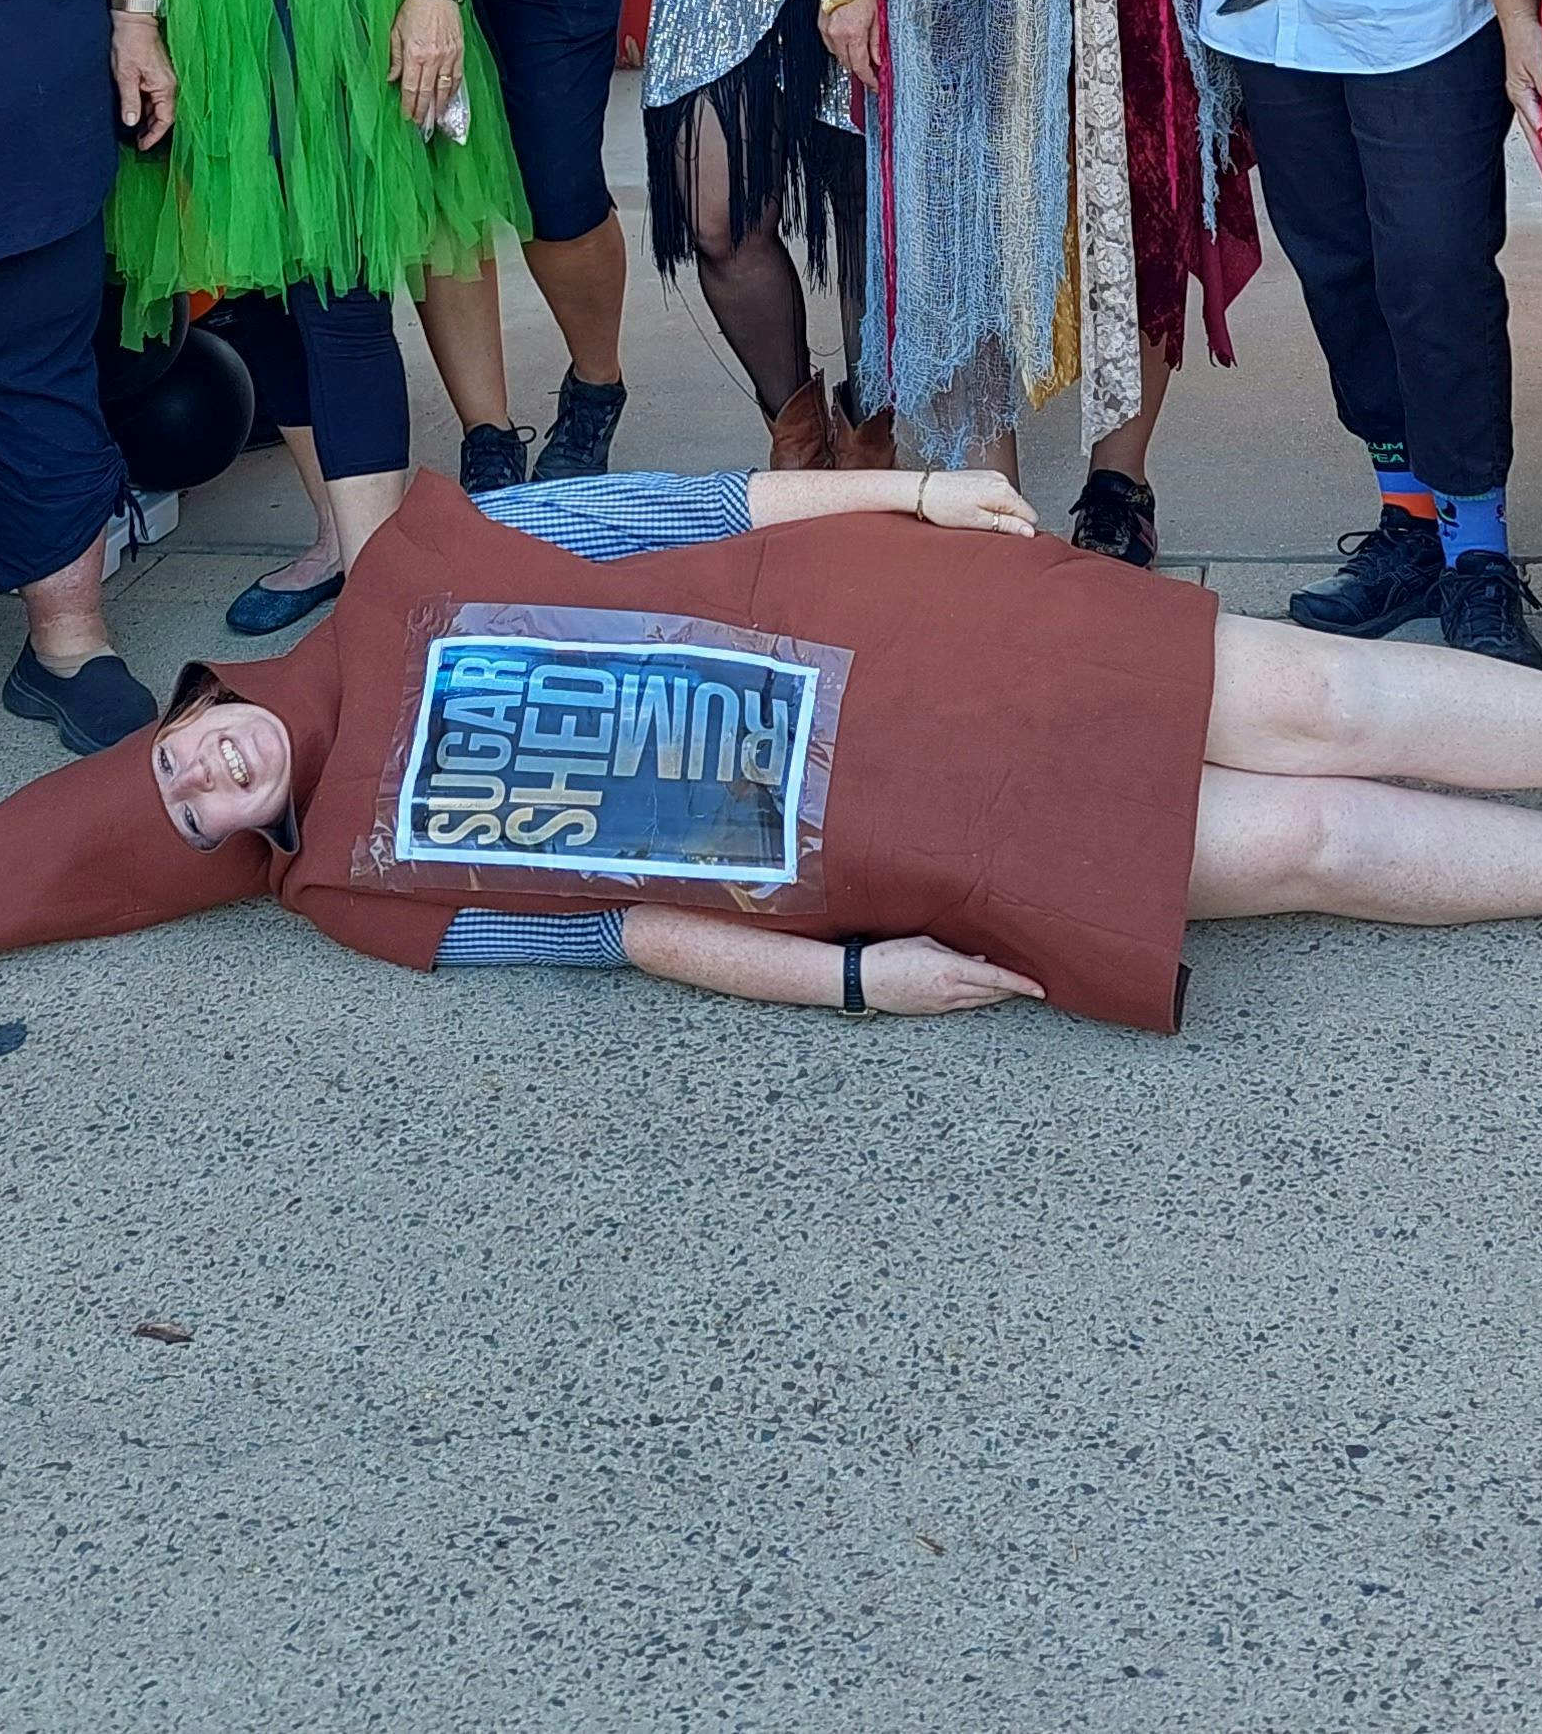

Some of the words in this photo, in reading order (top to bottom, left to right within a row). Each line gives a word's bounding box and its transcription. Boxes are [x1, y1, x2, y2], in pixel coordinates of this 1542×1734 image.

[426, 655, 529, 846] SUGAR
[504, 663, 617, 847] SHED
[612, 672, 790, 787] RUM
